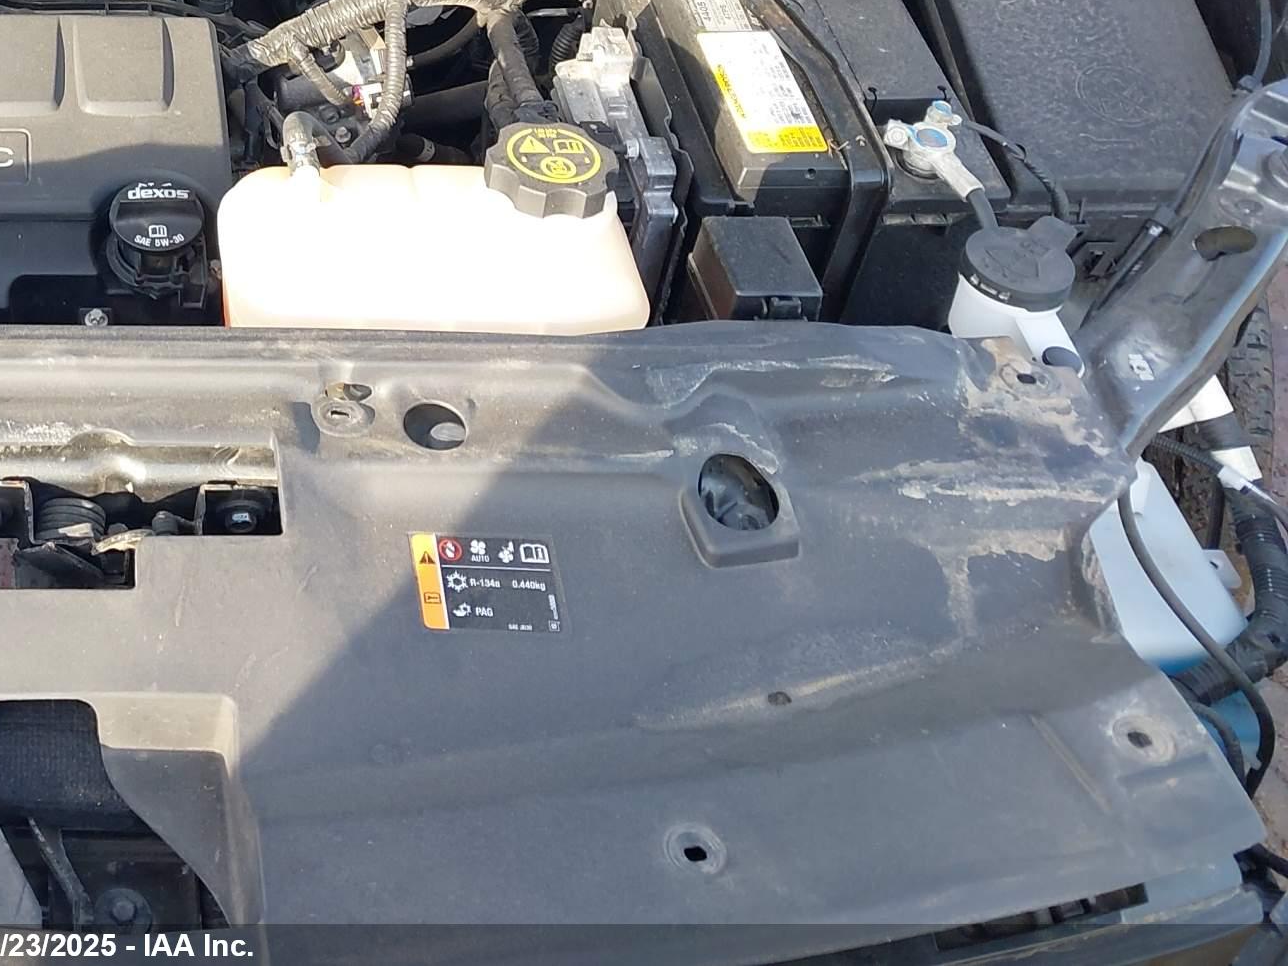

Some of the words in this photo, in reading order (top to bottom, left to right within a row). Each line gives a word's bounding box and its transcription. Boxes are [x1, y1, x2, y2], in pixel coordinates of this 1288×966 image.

[127, 185, 191, 200] dexos
[134, 234, 152, 247] SAE
[154, 233, 185, 247] 5W-30
[471, 555, 490, 563] AUTO
[470, 578, 500, 588] R-134a
[475, 607, 494, 617] PAG
